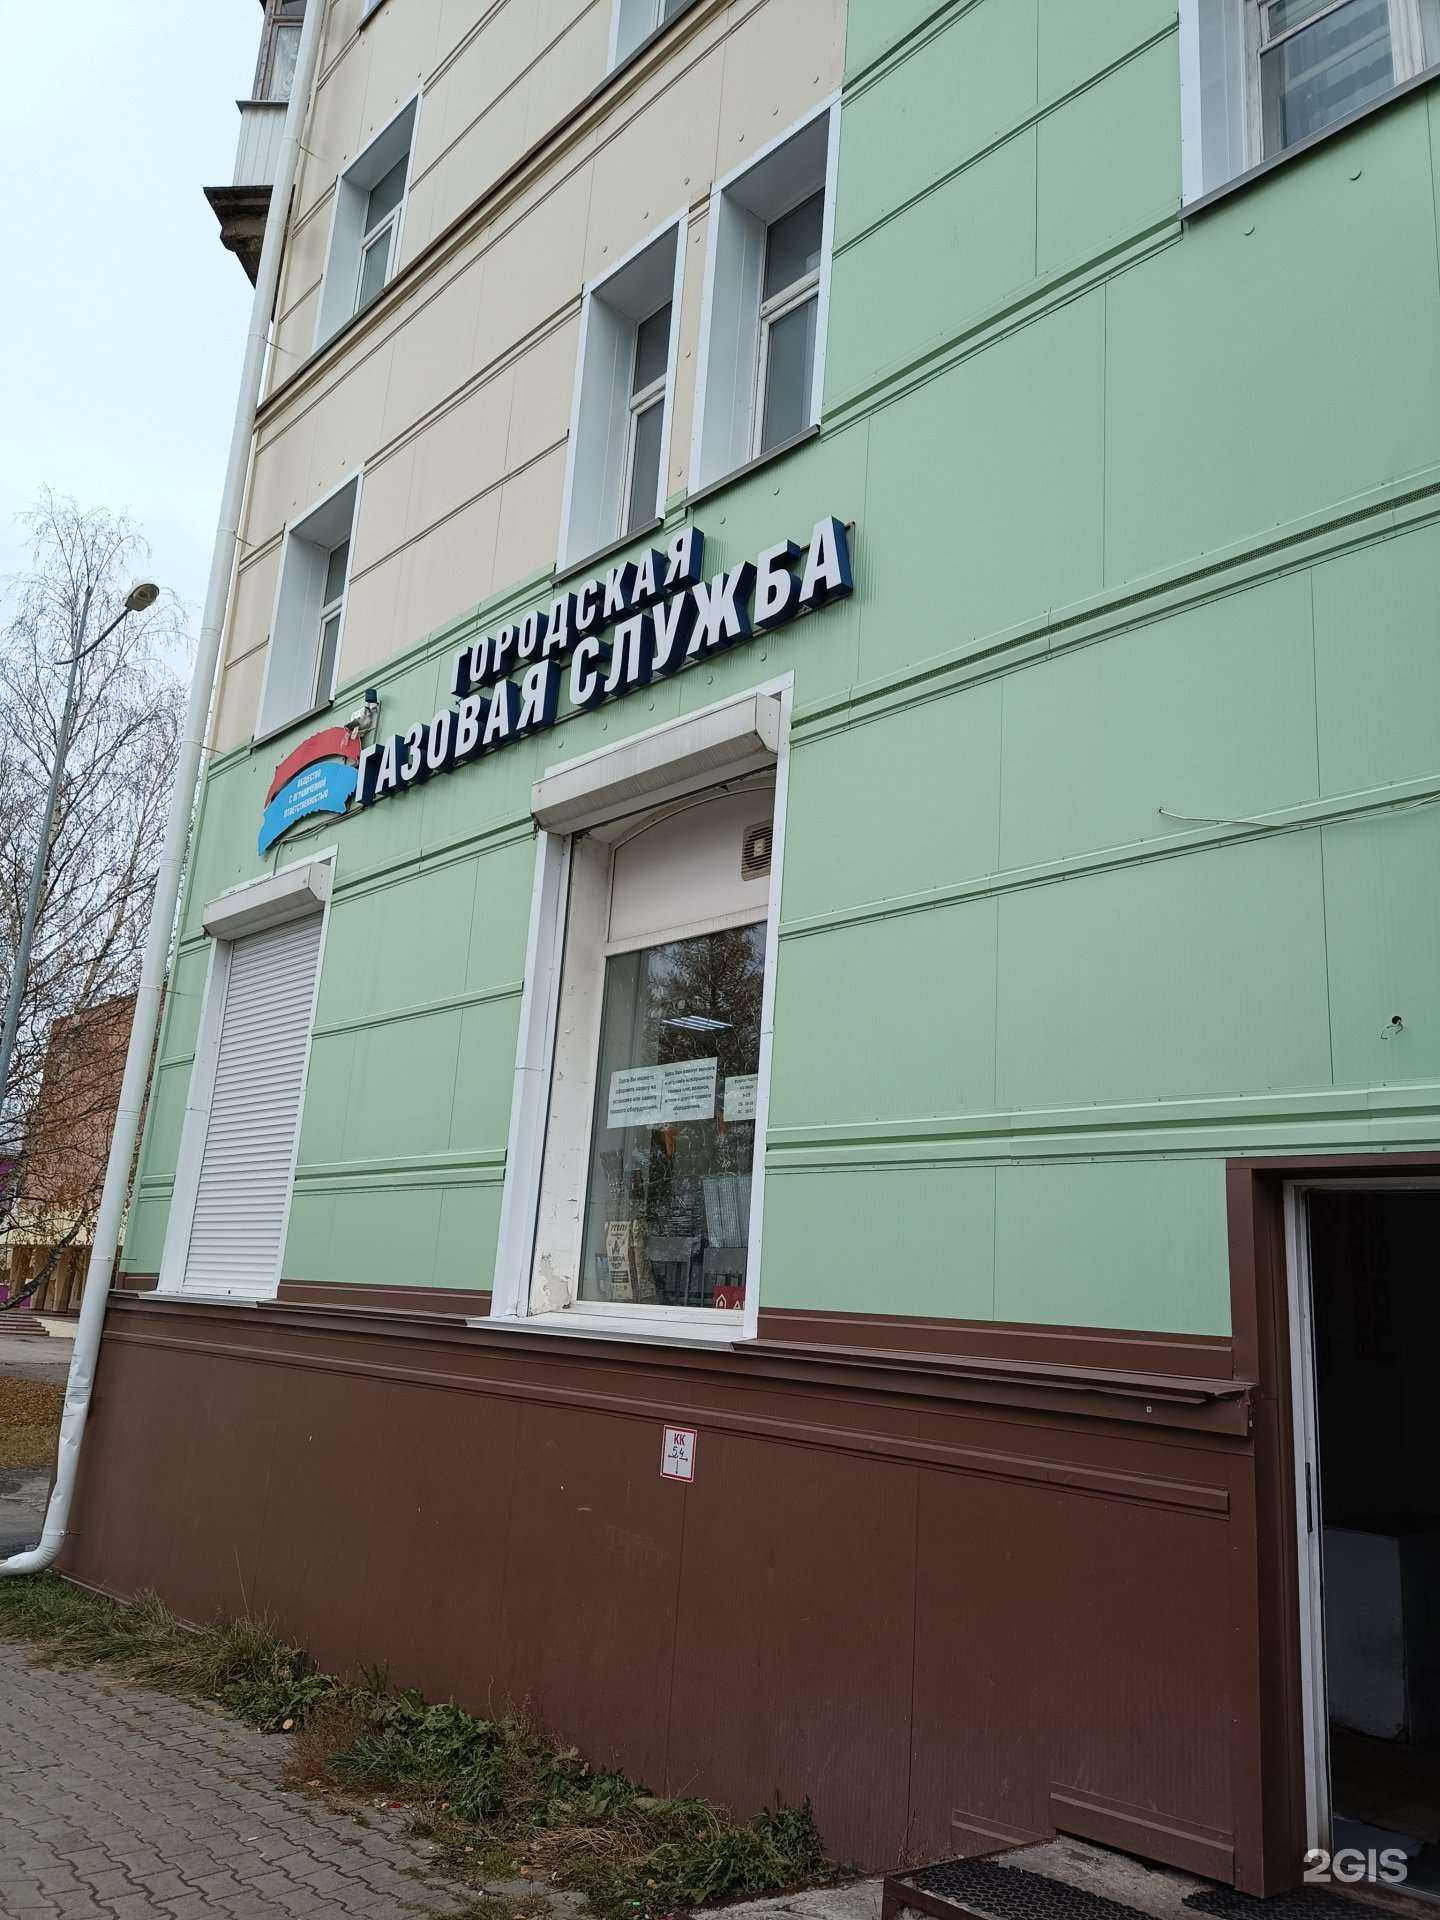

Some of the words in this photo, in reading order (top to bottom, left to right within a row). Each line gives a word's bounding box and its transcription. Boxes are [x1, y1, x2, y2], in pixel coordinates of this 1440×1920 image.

[355, 659, 552, 803] ГАЗОВАЯ
[569, 515, 846, 706] СЛУЖБА
[450, 526, 697, 696] ГОРОДСКАЯ
